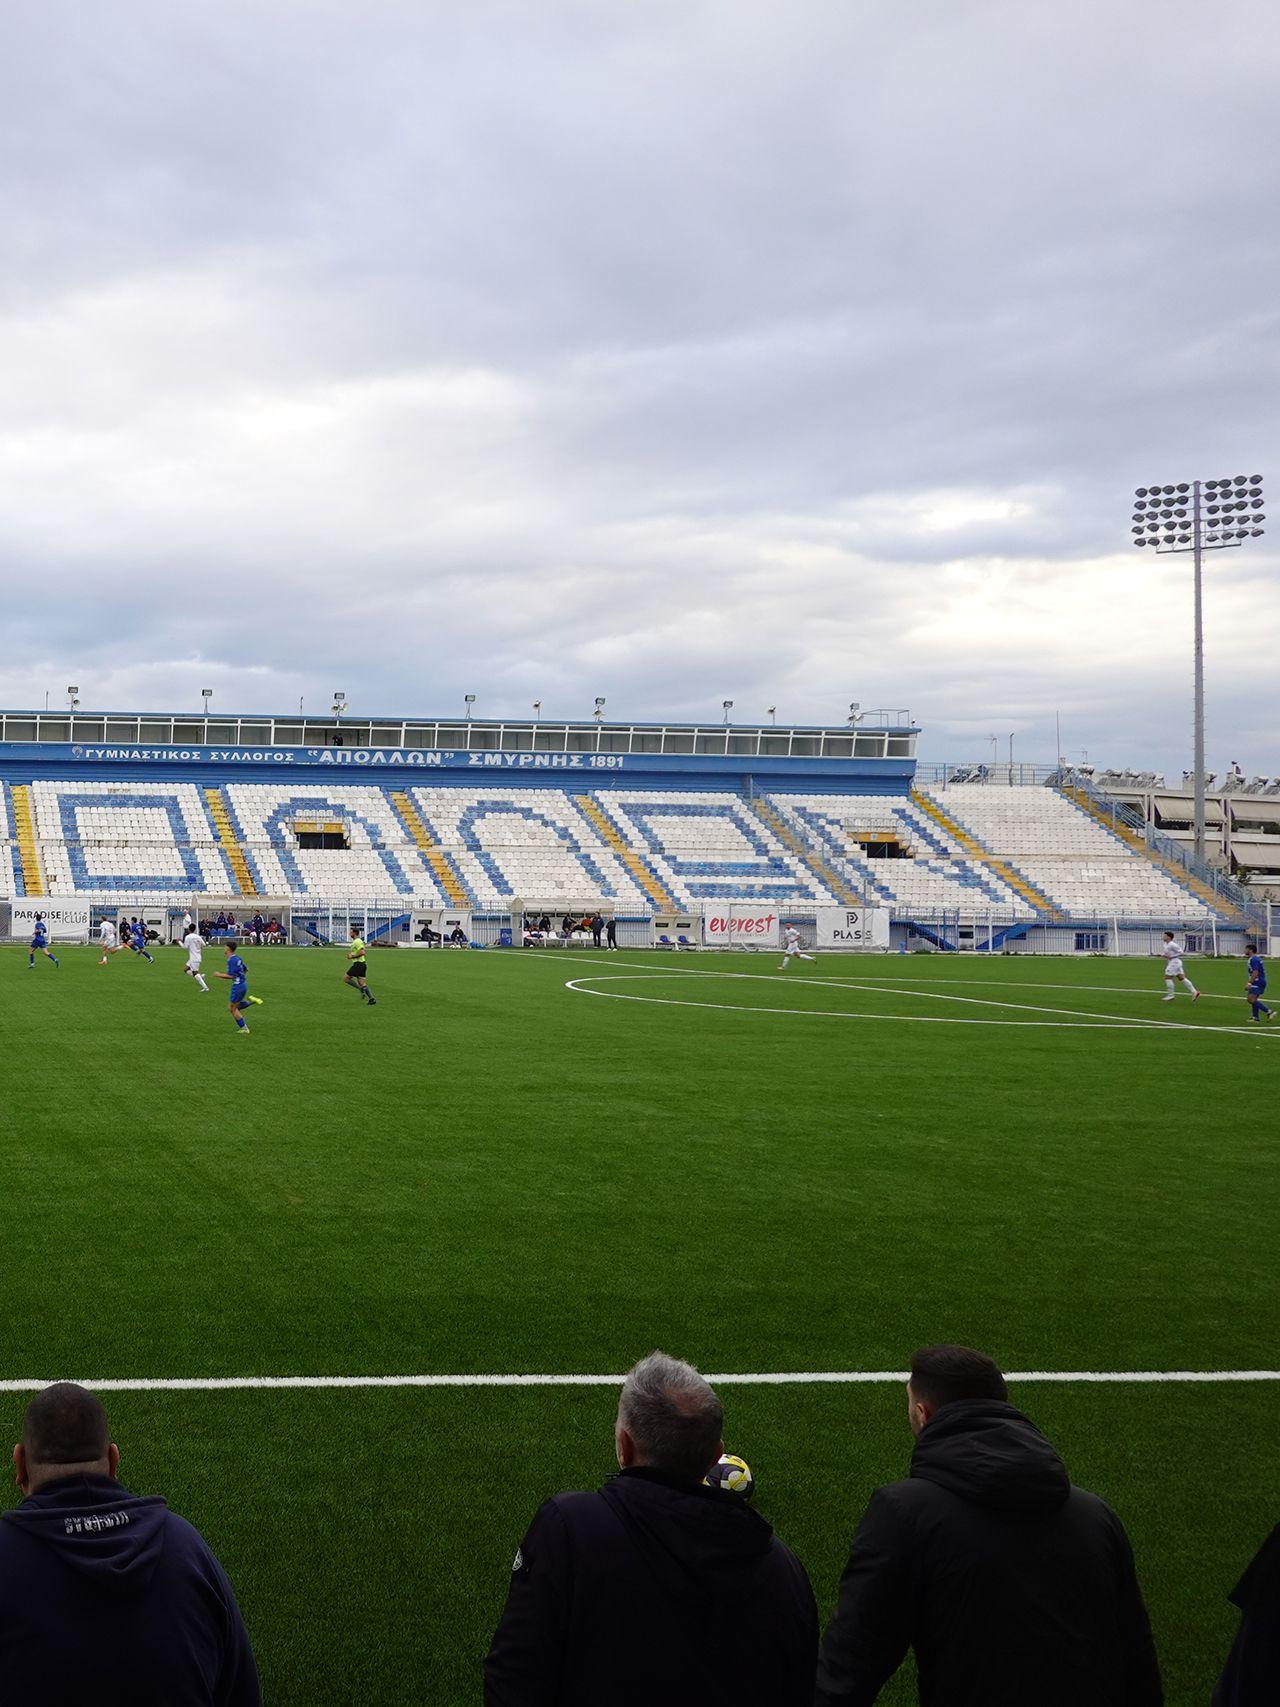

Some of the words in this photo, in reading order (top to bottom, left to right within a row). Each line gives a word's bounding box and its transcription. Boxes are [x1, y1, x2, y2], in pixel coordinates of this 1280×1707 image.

[85, 749, 201, 760] ΓΥΜΝΑΣΤΙΚΟΣ
[210, 751, 294, 761] ΣΥΛΛΟΓΟΣ
[469, 752, 583, 766] ΣΜΥΡΝΗΣ
[589, 755, 624, 767] 1891
[64, 915, 88, 924] CLUB
[709, 914, 777, 932] everest
